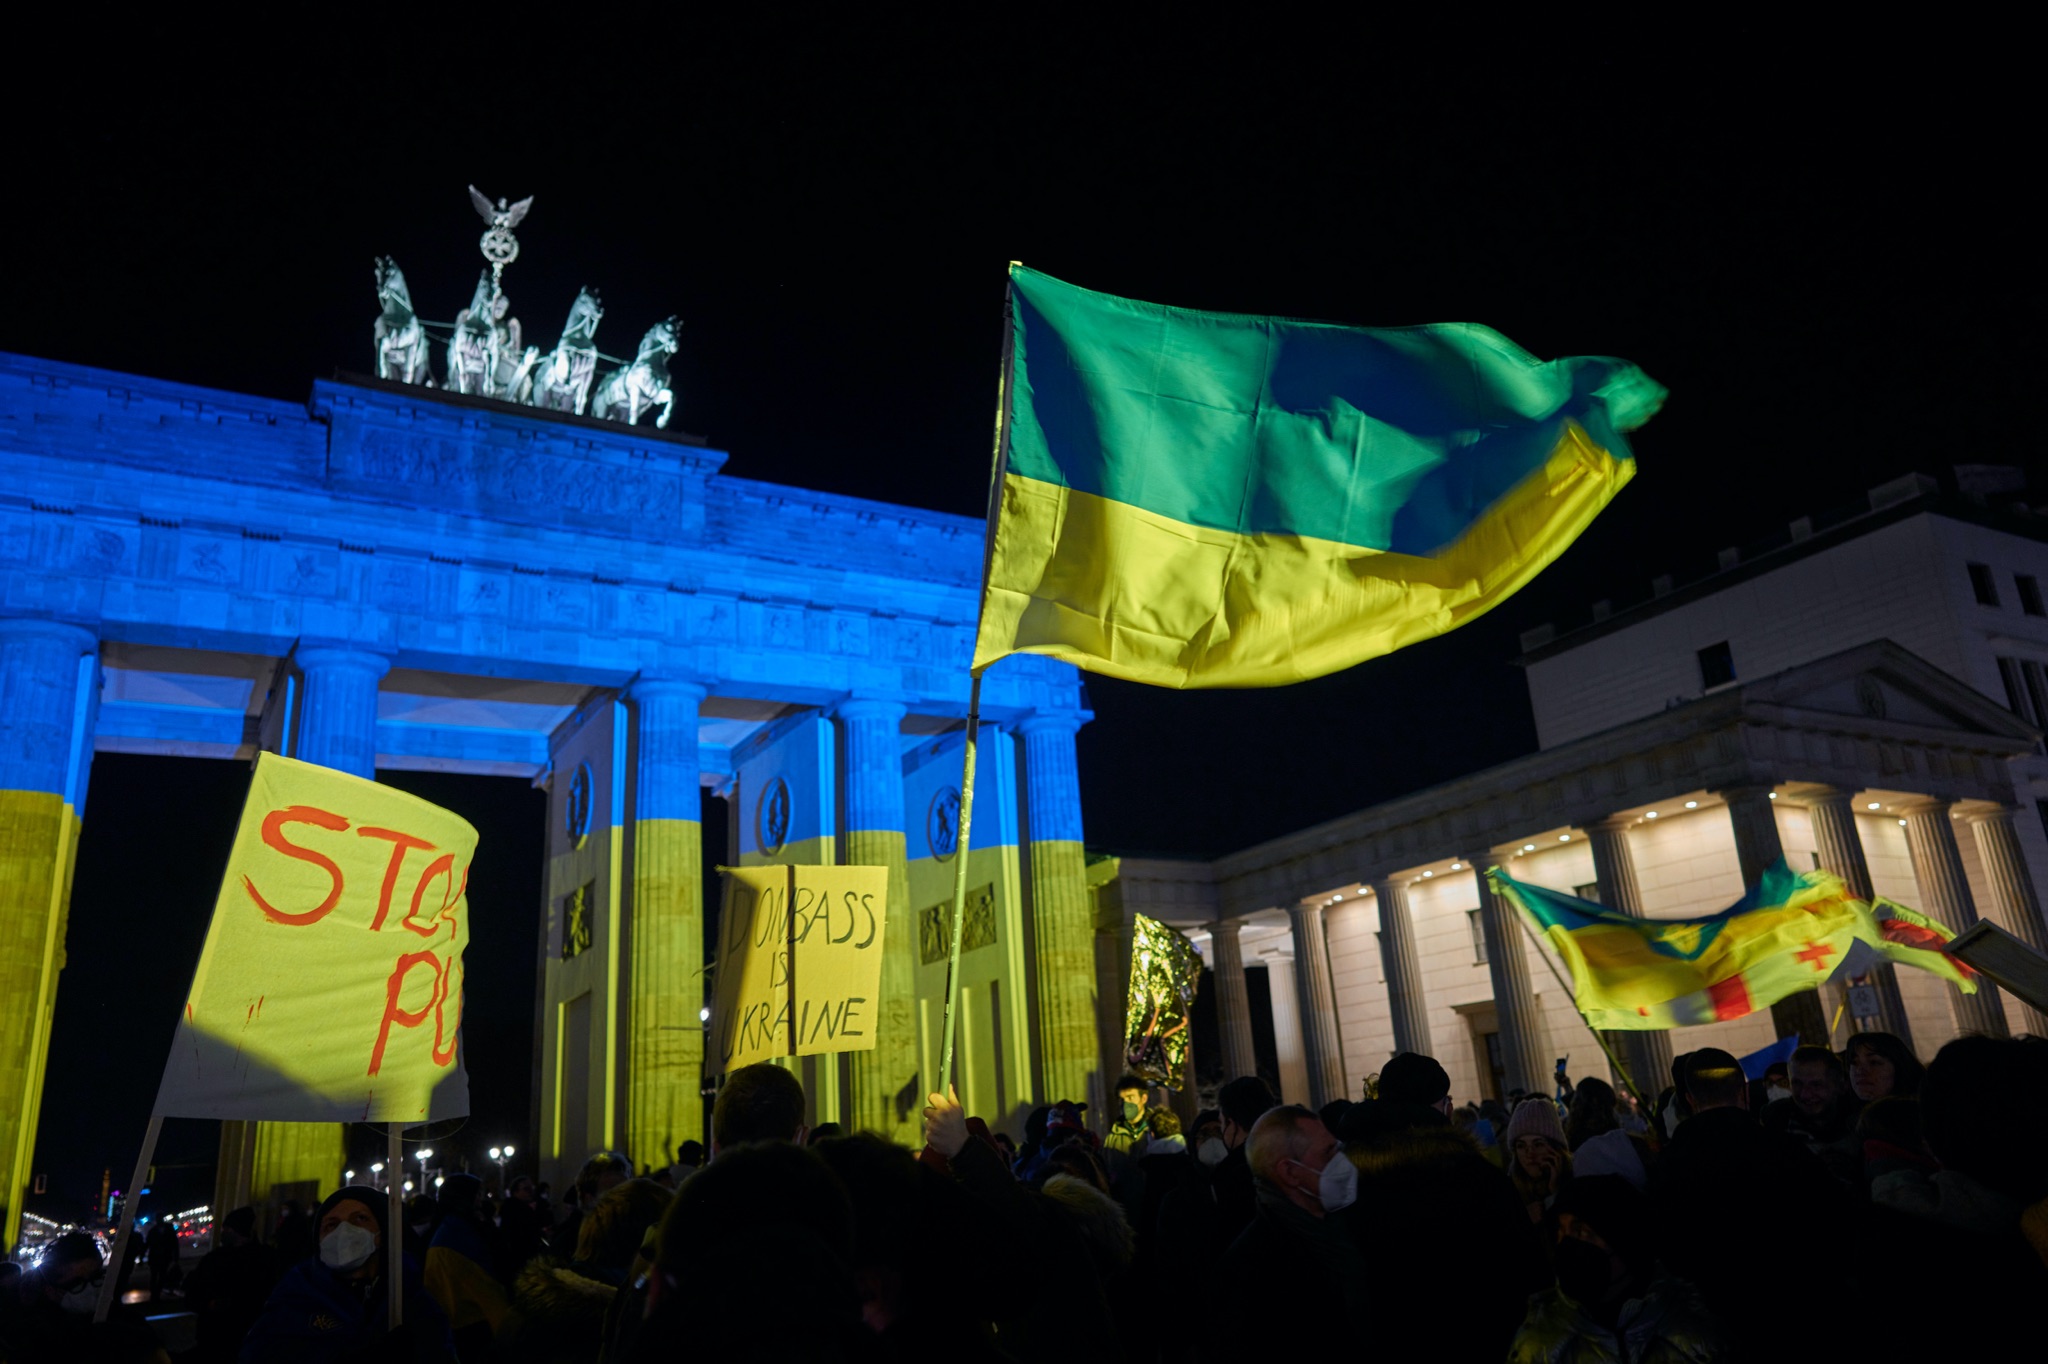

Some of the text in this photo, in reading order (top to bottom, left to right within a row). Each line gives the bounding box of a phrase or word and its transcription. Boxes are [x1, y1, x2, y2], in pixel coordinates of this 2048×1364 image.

[727, 886, 876, 955] DONBASS
[769, 951, 789, 989] IS
[720, 997, 867, 1065] UKRAINE
